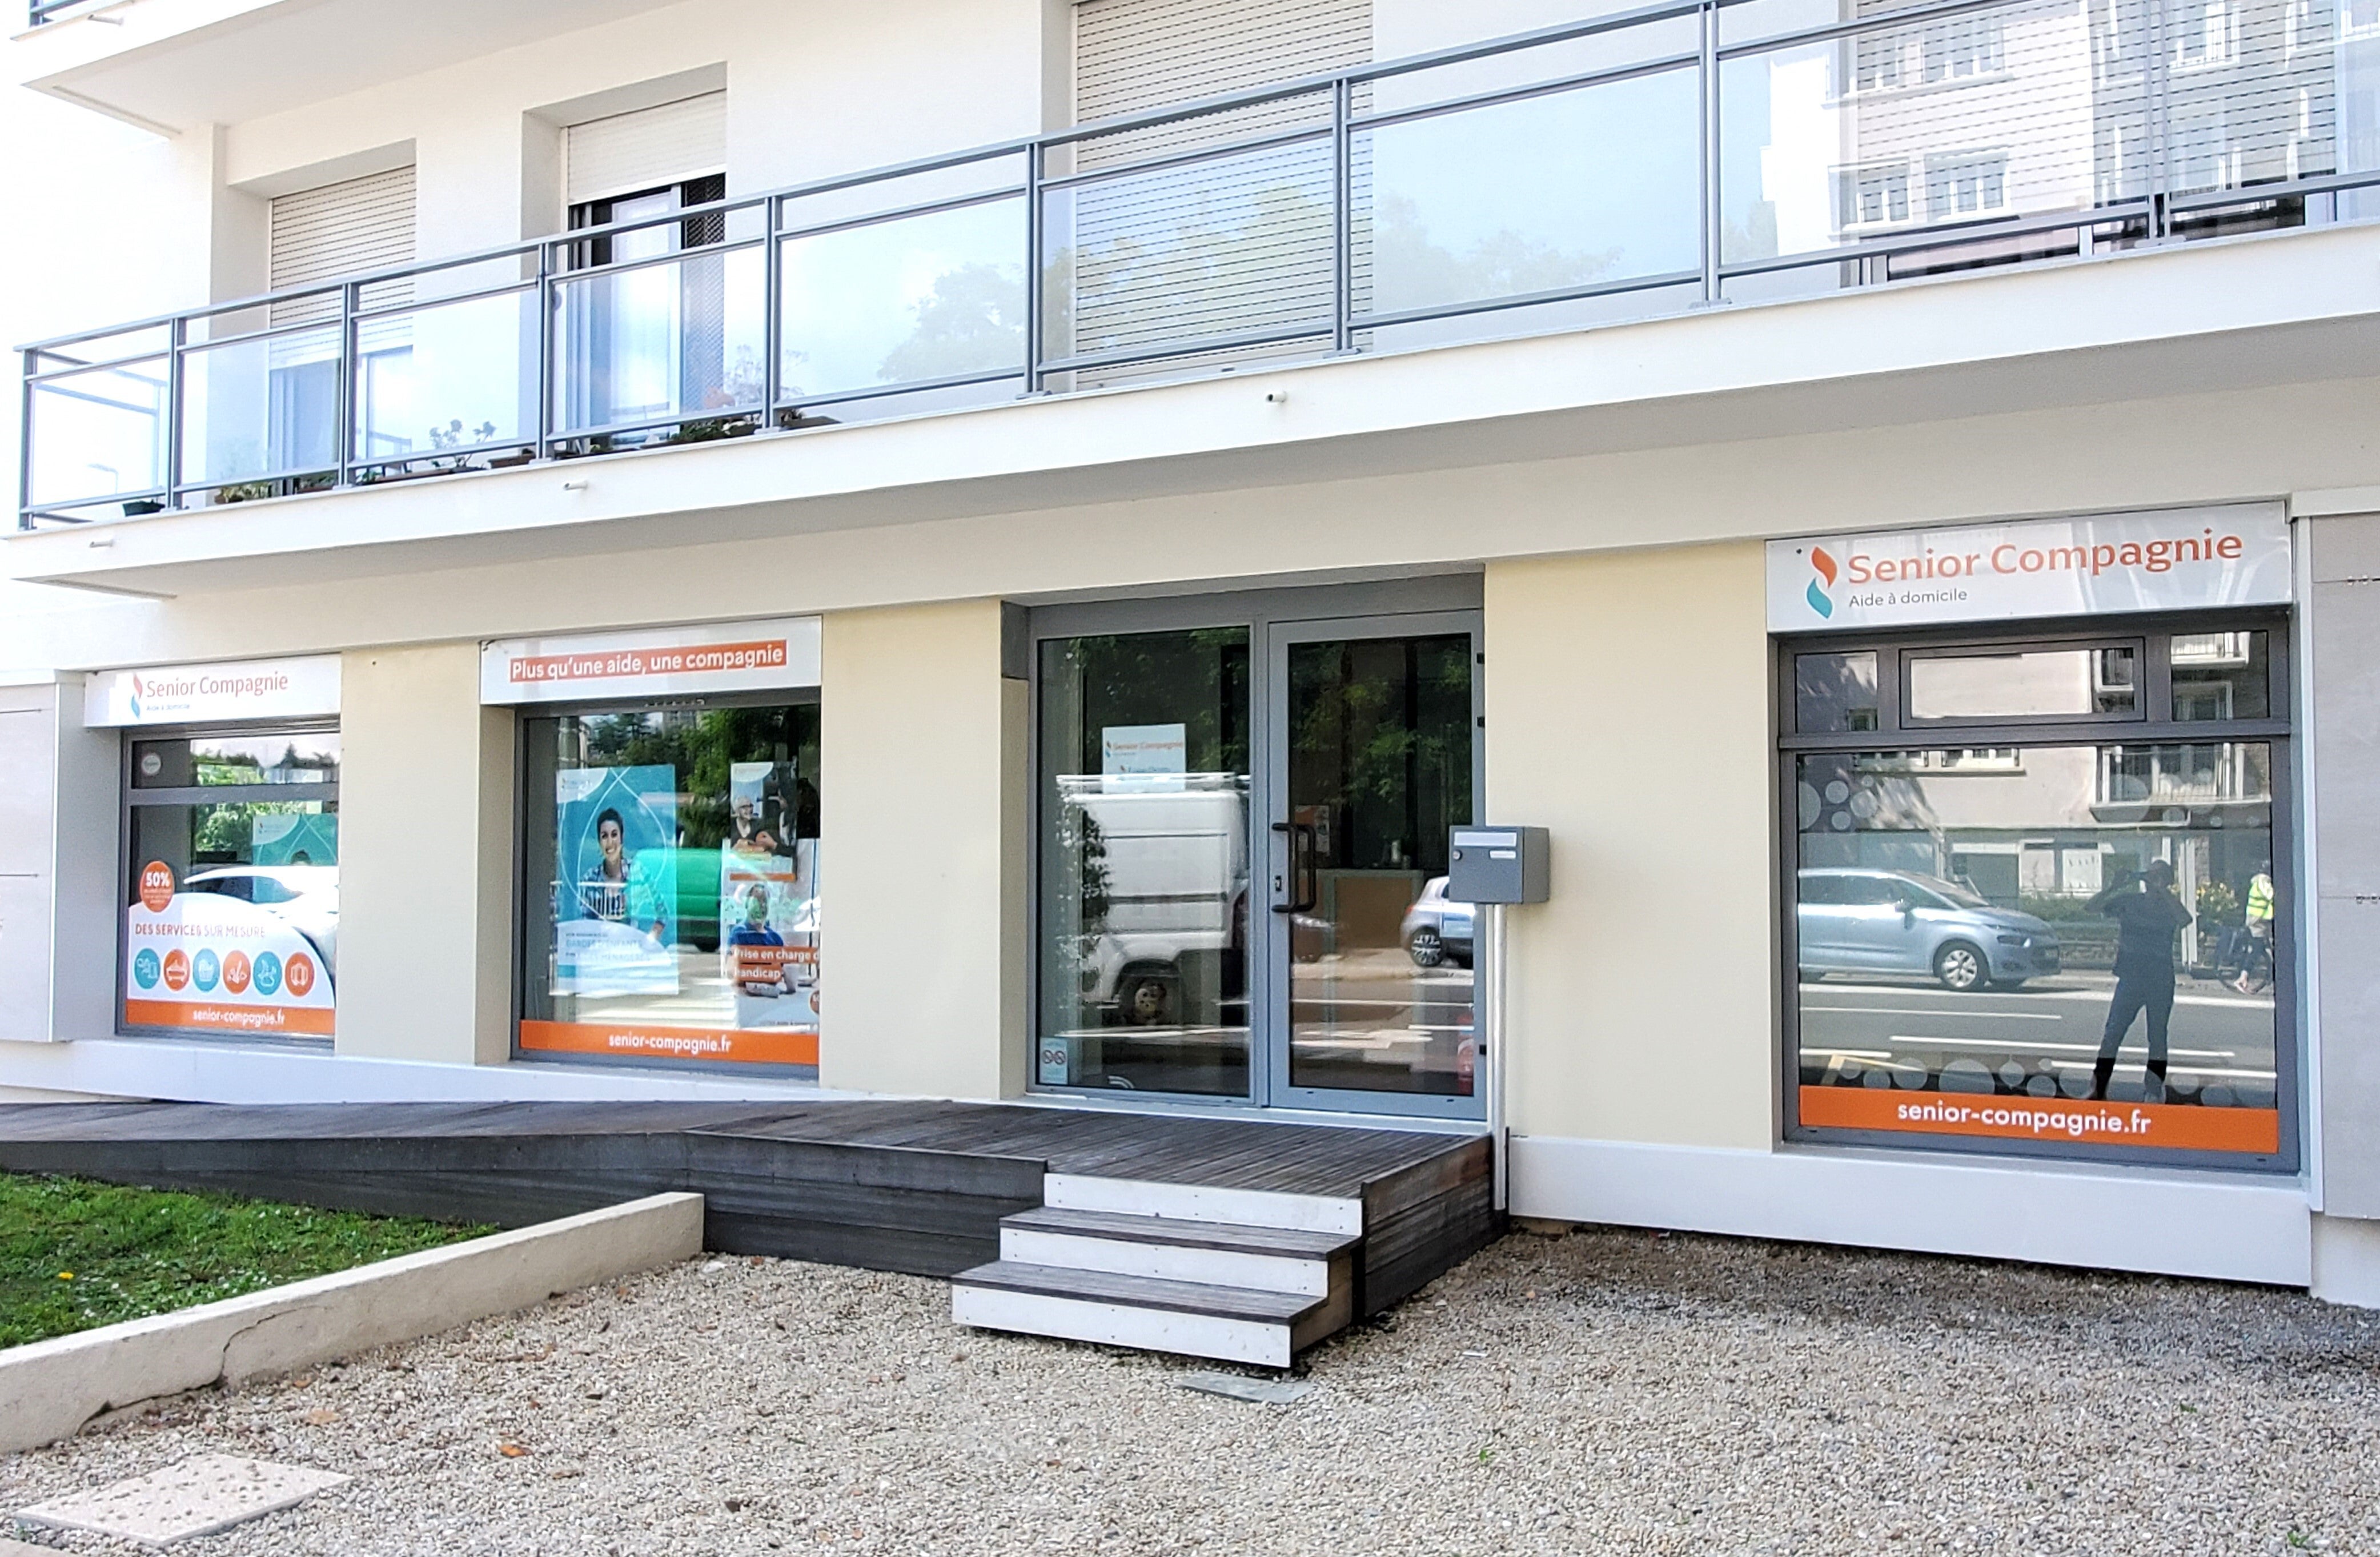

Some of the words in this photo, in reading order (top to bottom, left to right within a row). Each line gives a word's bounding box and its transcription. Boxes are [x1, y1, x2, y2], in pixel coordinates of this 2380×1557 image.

[1848, 548, 1981, 584] Senior
[1991, 528, 2243, 576] Compagnie
[1849, 593, 1884, 607] Aide
[1888, 592, 1896, 605] à
[1901, 588, 1968, 604] domicile
[512, 660, 544, 679] Plus
[607, 653, 647, 675] aide,
[651, 655, 683, 671] une
[685, 644, 784, 670] compagnie
[147, 677, 196, 698] Senior
[200, 671, 288, 698] Compagnie
[146, 872, 170, 887] 50%
[135, 923, 154, 936] DES
[155, 923, 202, 936] SERVICES
[204, 925, 223, 937] SUR
[761, 950, 774, 960] en
[776, 948, 812, 963] charge
[192, 1006, 285, 1028] senior-compagnie.fr
[608, 1030, 732, 1056] senior-compagnie.fr
[1897, 1099, 2152, 1137] senior-compagnie.fr
